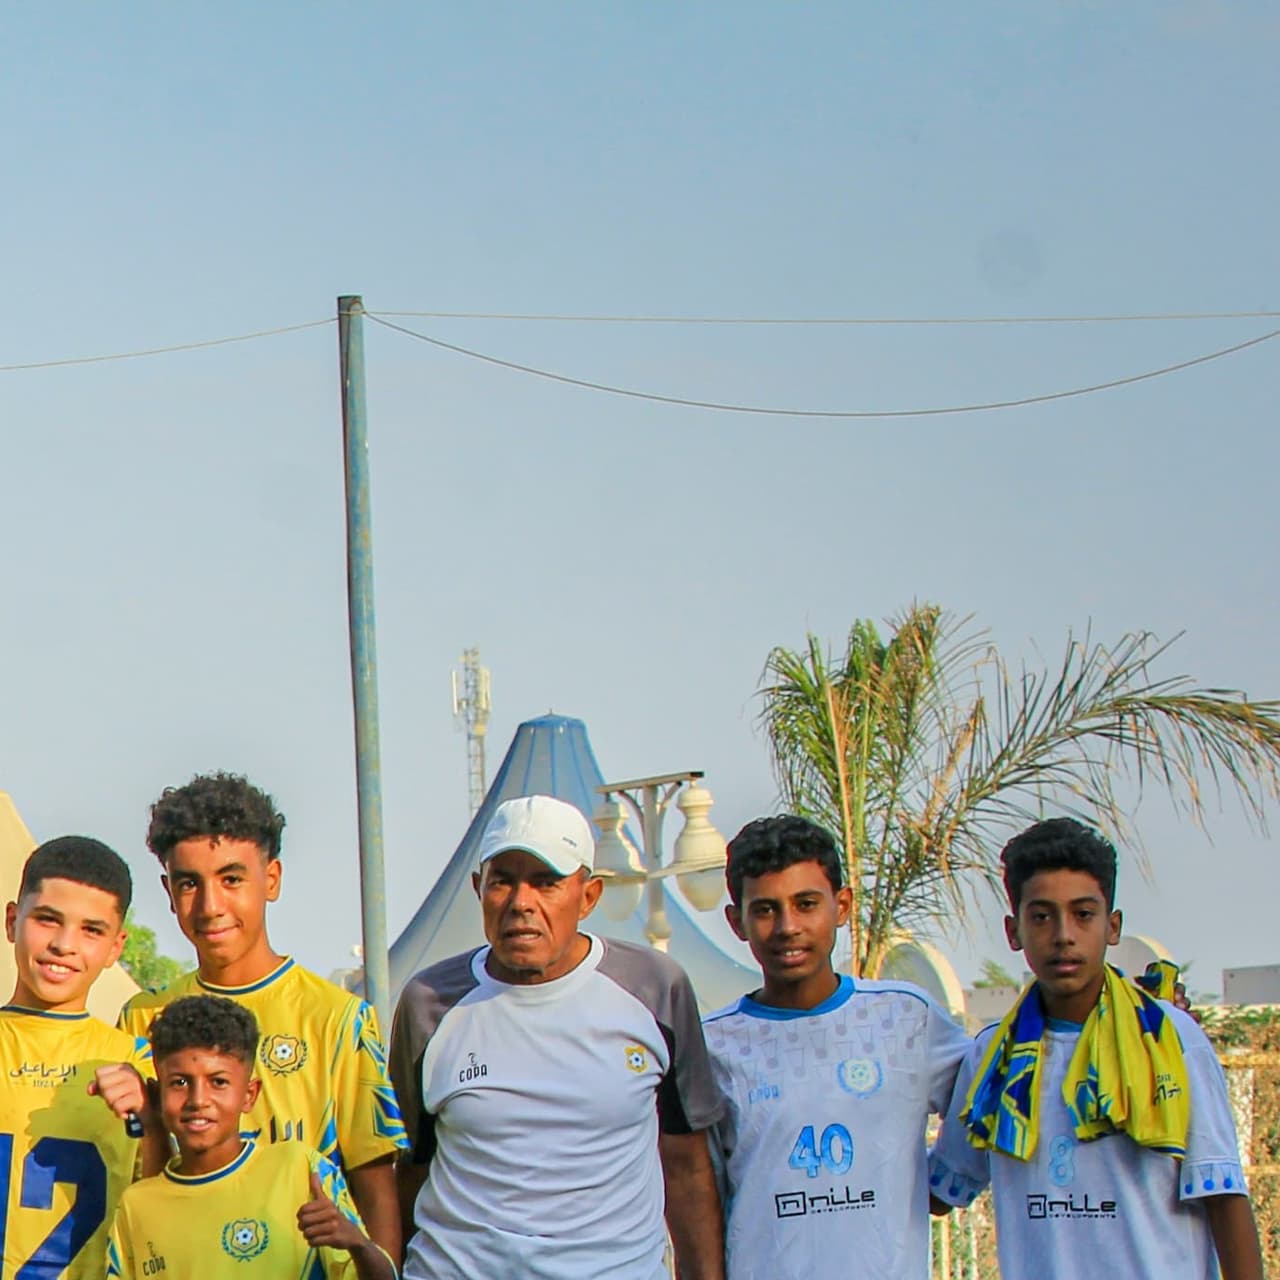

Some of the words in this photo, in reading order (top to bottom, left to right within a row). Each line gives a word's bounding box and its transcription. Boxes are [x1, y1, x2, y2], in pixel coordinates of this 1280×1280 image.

[459, 1064, 488, 1083] COPA
[789, 1123, 854, 1179] 40
[1048, 1136, 1075, 1188] 8
